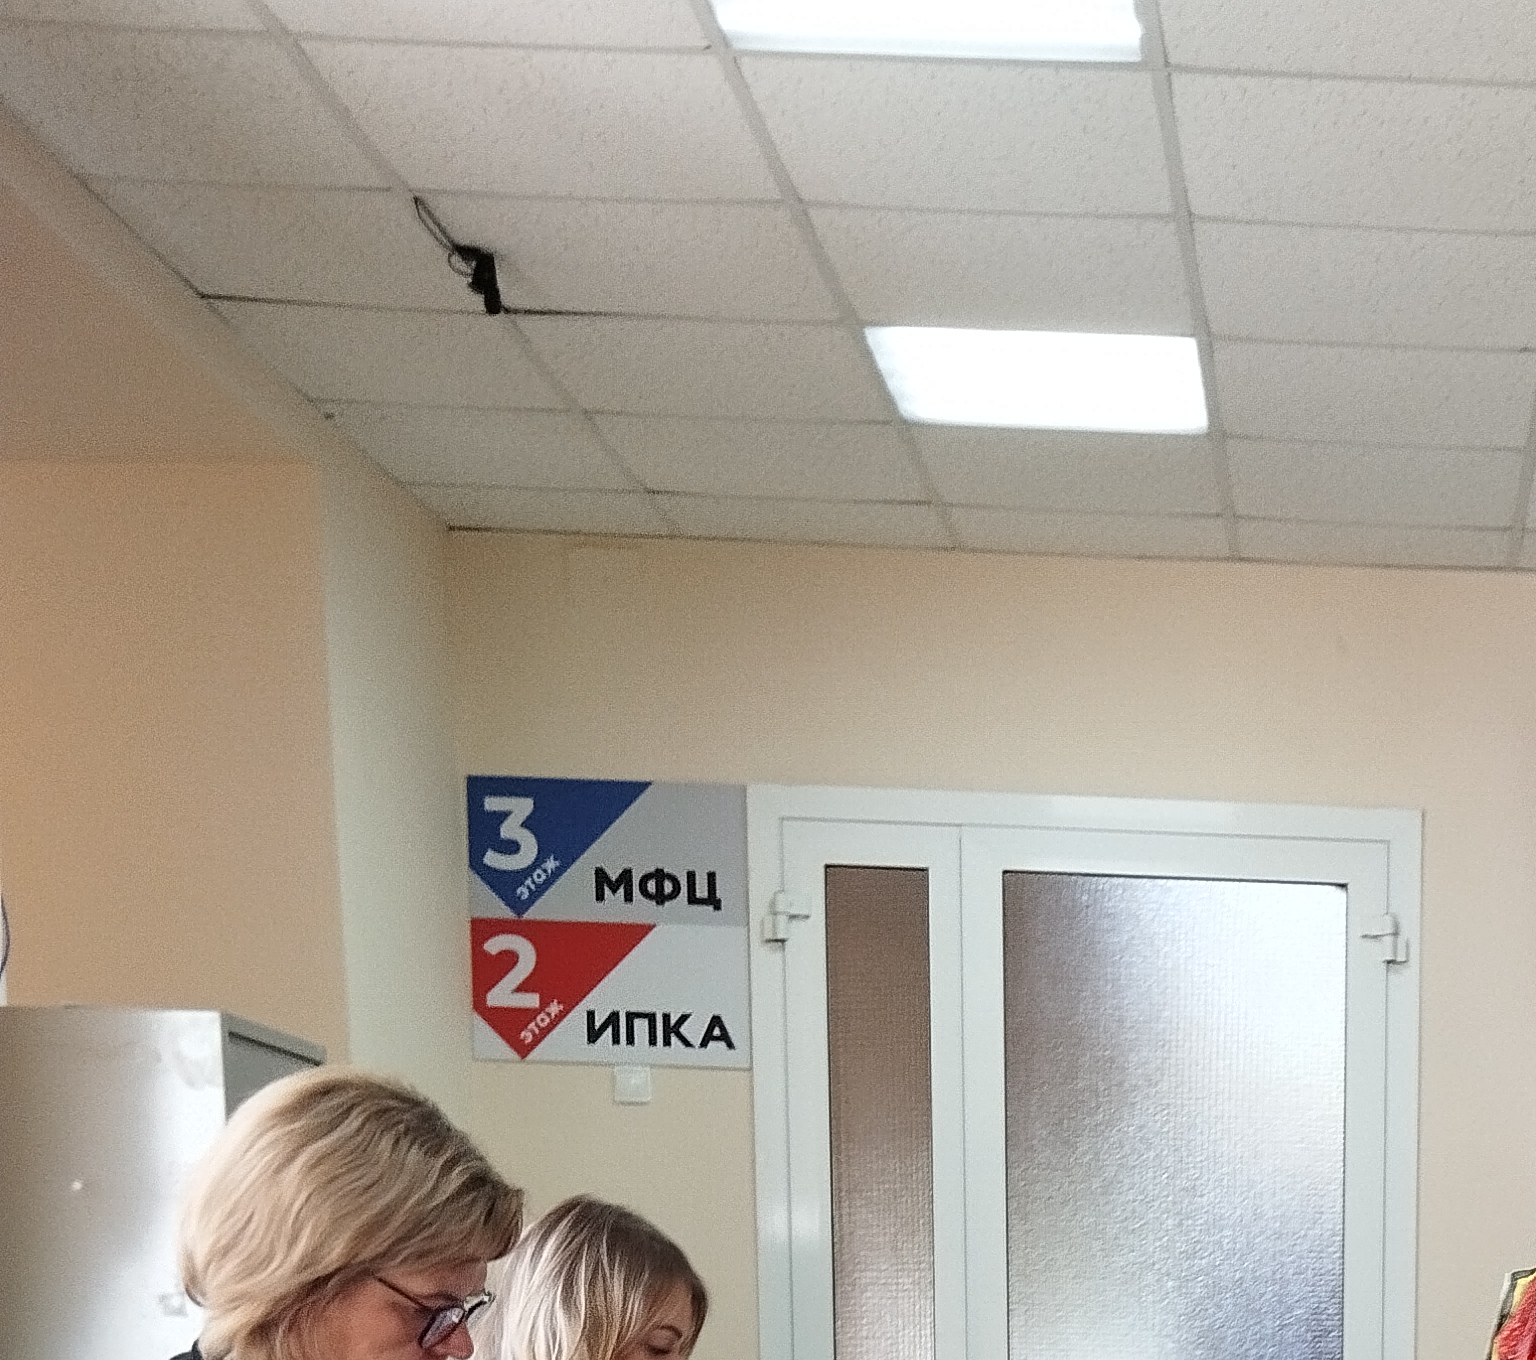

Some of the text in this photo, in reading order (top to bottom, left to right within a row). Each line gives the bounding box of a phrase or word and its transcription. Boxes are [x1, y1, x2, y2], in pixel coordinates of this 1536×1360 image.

[483, 796, 538, 871] 3
[516, 854, 560, 900] этаж
[594, 866, 722, 911] МФЦ
[483, 933, 540, 1008] 2
[520, 998, 564, 1045] этаж
[586, 1009, 736, 1050] ИПКА
